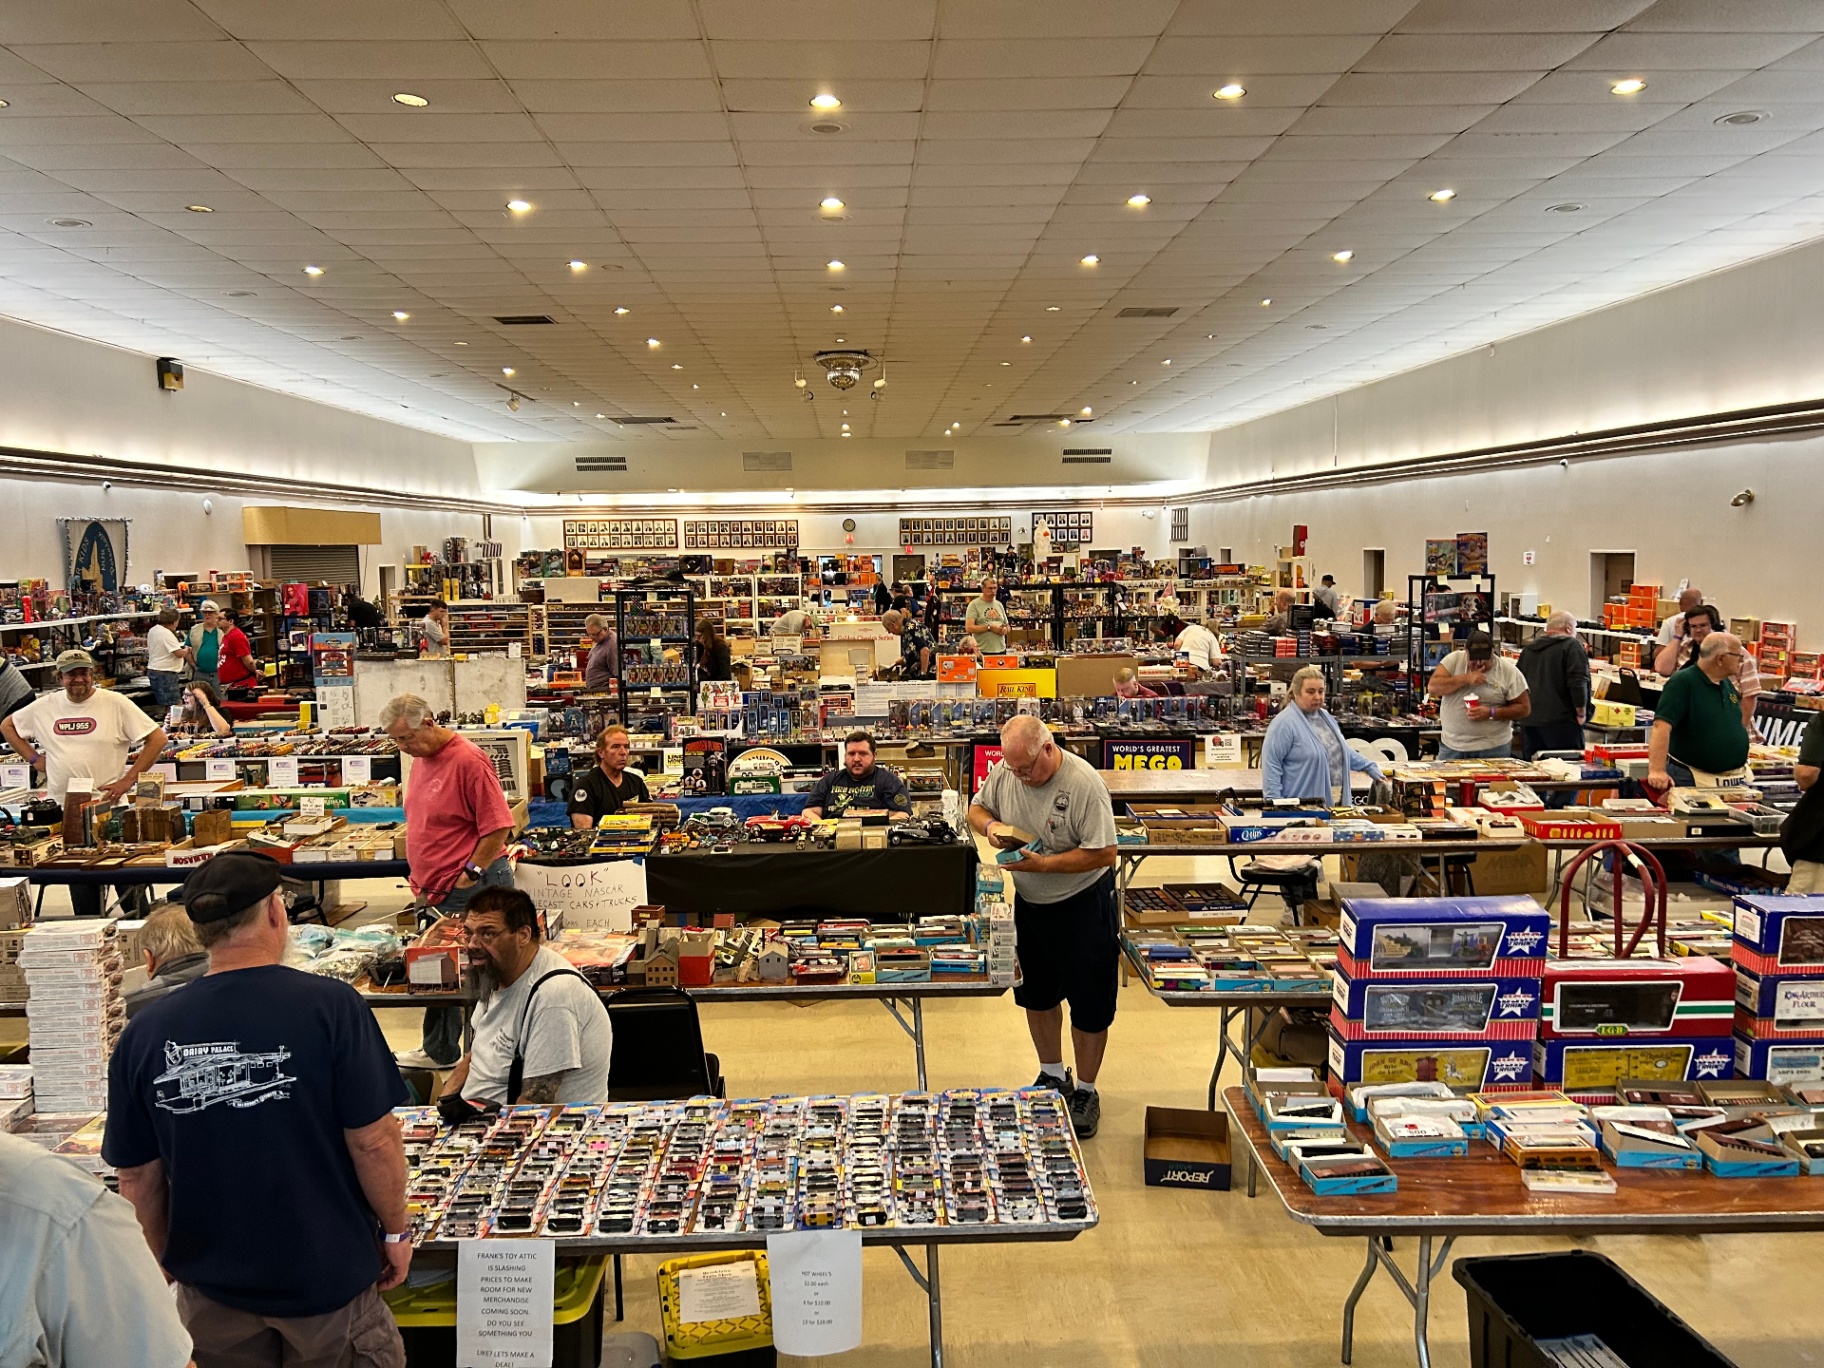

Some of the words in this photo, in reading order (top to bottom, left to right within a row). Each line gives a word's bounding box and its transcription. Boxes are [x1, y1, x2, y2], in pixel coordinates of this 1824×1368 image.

[59, 723, 76, 731] WPLJ
[985, 749, 1004, 757] WORL
[1112, 745, 1145, 753] WORLD'S
[1146, 745, 1180, 753] GREATEST
[1113, 754, 1183, 770] MEGO
[584, 884, 624, 898] NASCAR
[534, 900, 564, 909] IECAST
[600, 896, 639, 908] TRUCKS
[586, 919, 610, 928] EACH
[1785, 990, 1801, 1000] KING
[1792, 1001, 1817, 1009] FLOUR
[1601, 1026, 1624, 1034] LGB
[183, 1046, 209, 1057] DAIRY
[210, 1045, 234, 1054] PALACE
[1160, 1170, 1215, 1184] REPORT
